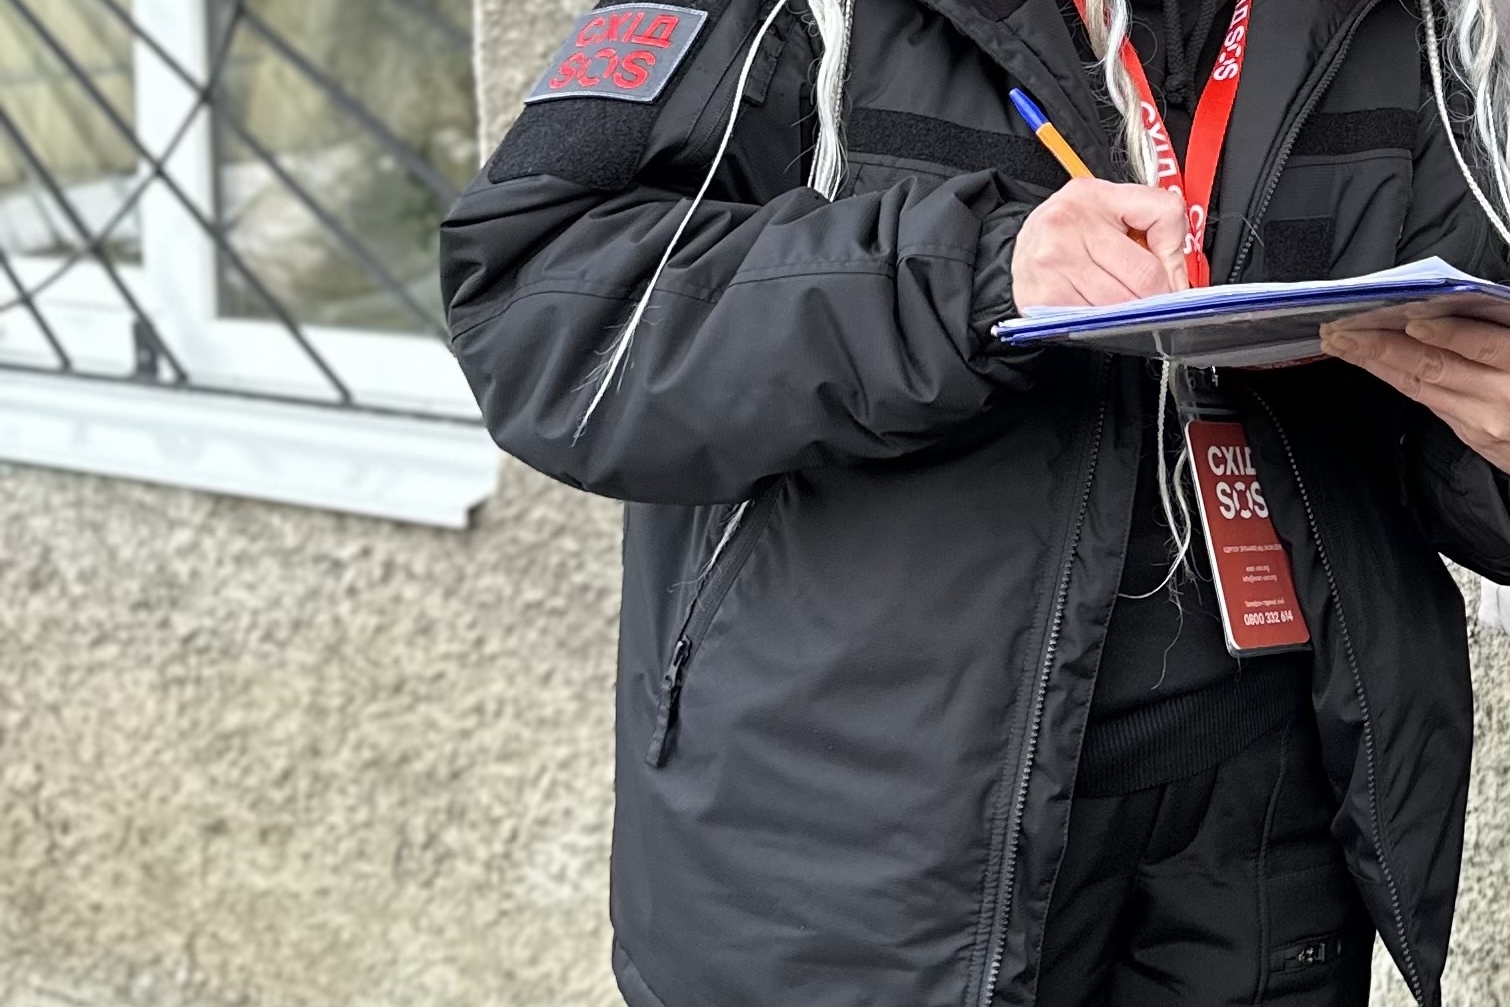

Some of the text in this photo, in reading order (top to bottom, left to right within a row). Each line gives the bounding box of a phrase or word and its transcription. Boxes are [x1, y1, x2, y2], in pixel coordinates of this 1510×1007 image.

[575, 11, 680, 49] СХІД
[549, 48, 656, 89] SOS
[1213, 25, 1245, 81] SOS
[1215, 481, 1269, 520] SOS
